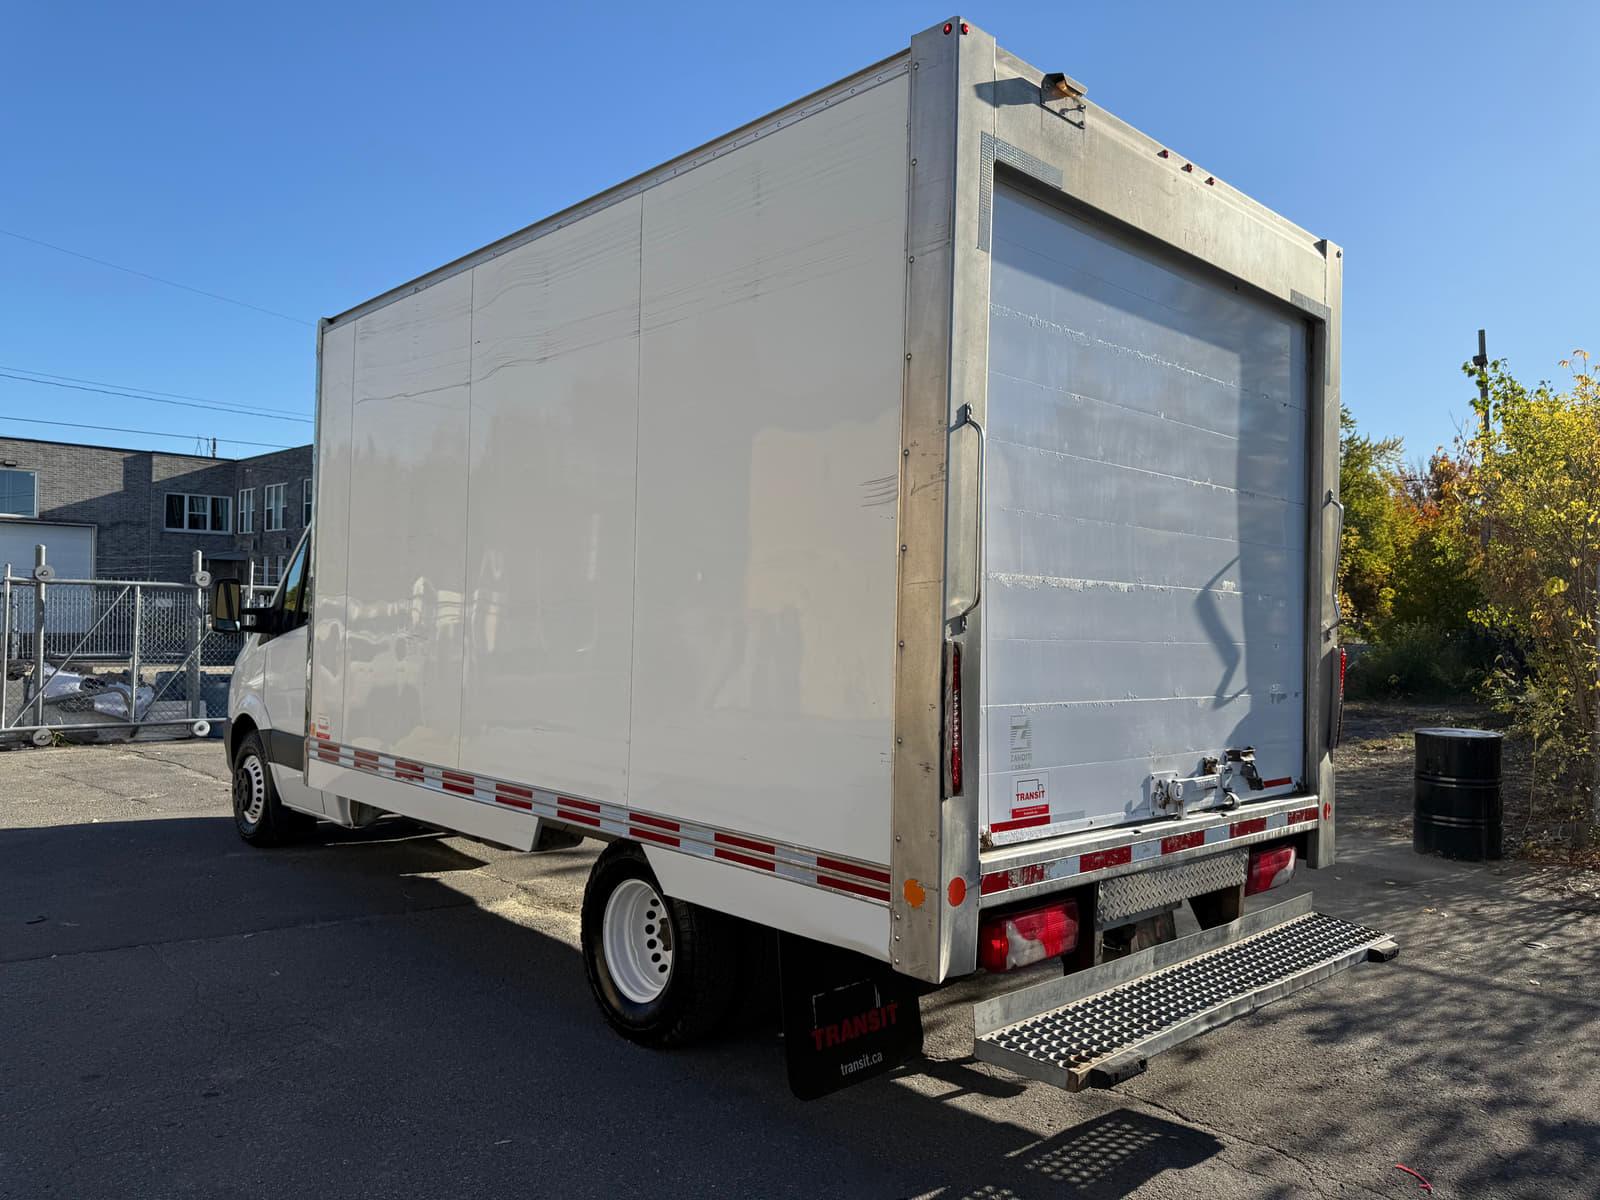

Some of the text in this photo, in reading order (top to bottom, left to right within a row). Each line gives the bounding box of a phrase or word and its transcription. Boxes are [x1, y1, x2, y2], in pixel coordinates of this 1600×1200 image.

[1015, 790, 1045, 801] TRANSIT
[811, 1002, 898, 1051] TRANSIT
[840, 1051, 883, 1076] transit.ca
